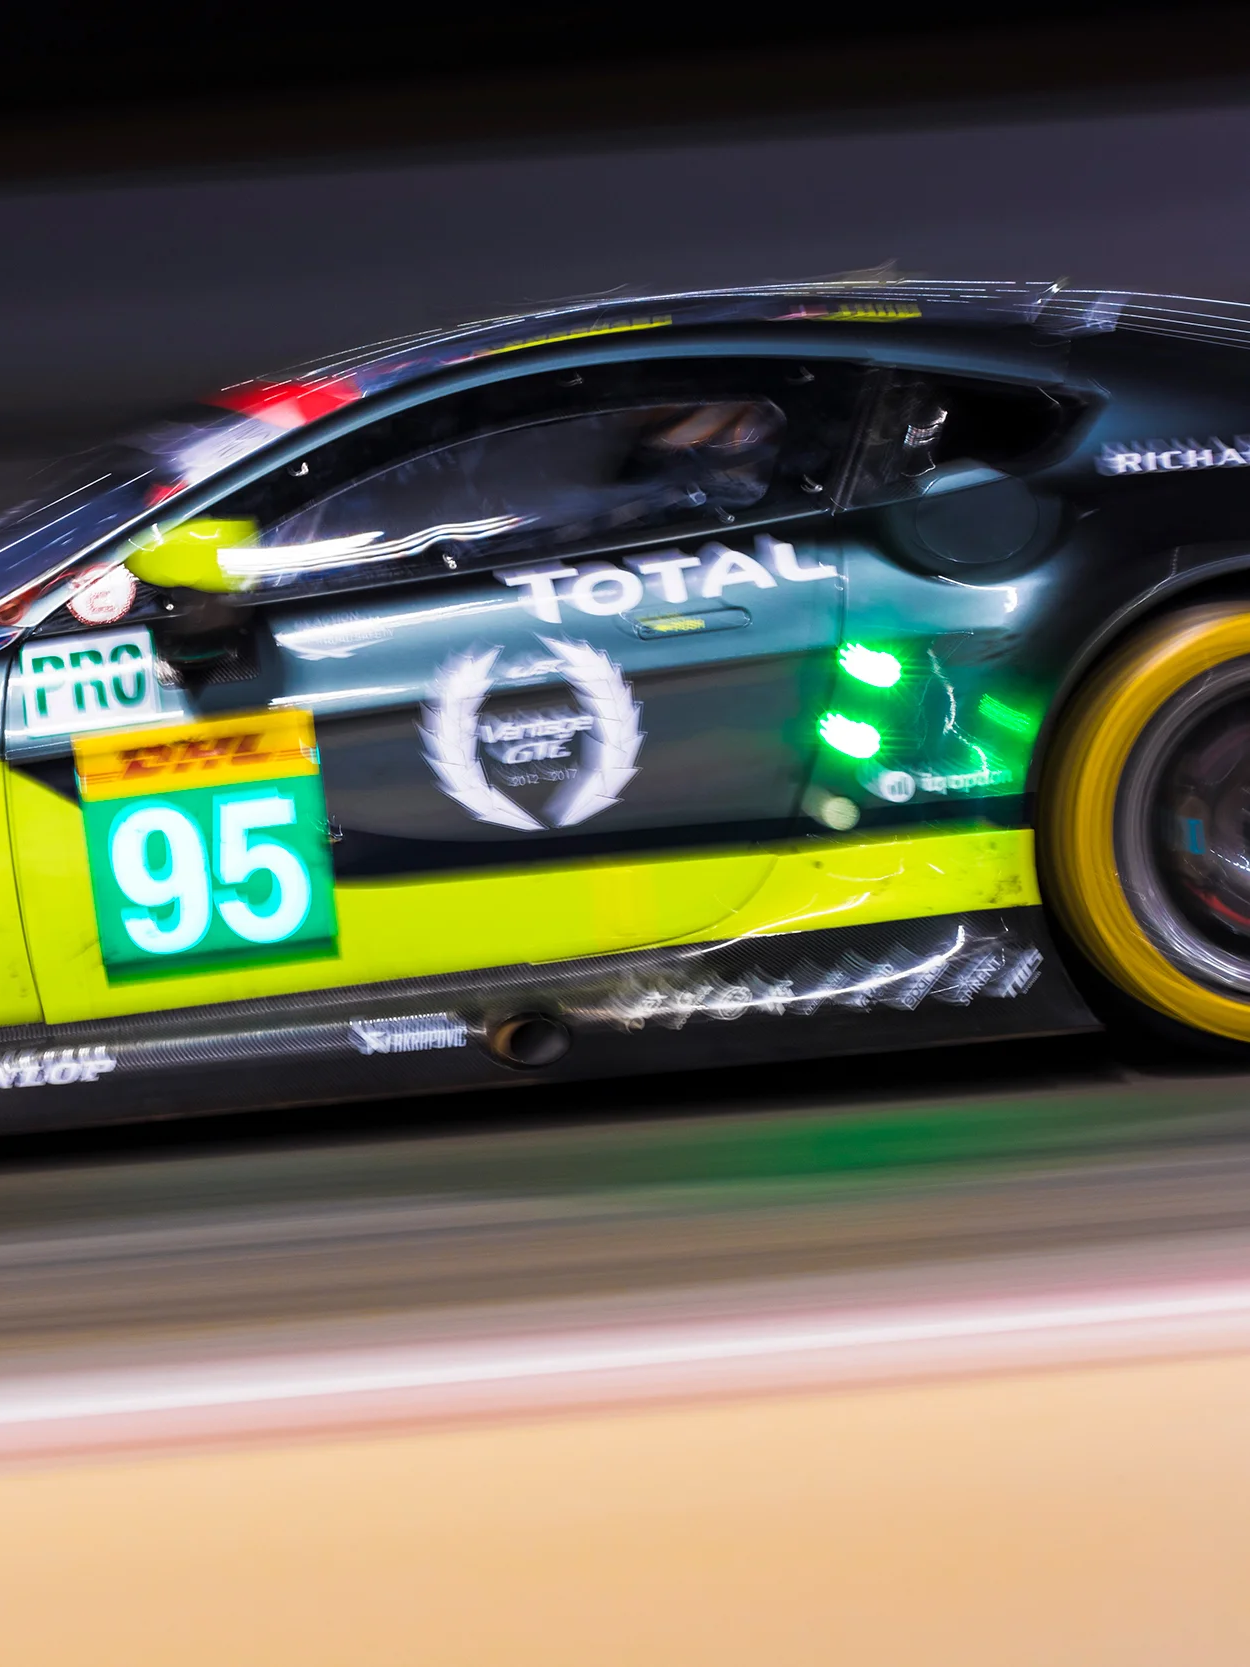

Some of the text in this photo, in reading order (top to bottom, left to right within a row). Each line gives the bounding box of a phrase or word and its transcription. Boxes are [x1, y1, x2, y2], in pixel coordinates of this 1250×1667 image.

[502, 541, 838, 624] TOTAL
[31, 643, 147, 717] PRO
[117, 733, 264, 779] DHL
[502, 739, 572, 764] GTE
[108, 787, 311, 955] 95
